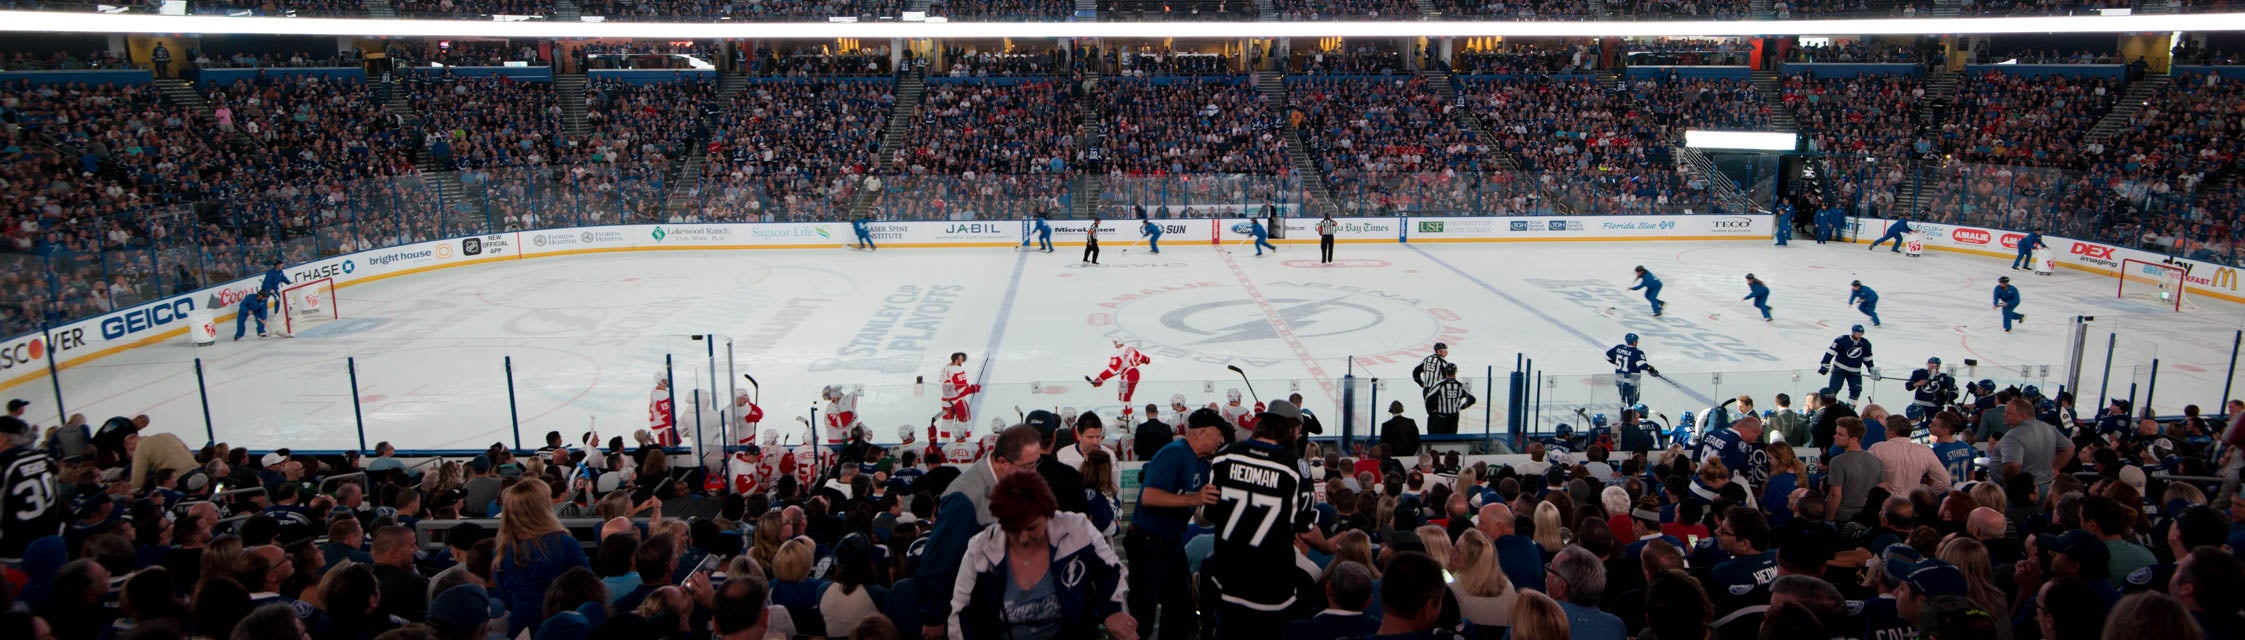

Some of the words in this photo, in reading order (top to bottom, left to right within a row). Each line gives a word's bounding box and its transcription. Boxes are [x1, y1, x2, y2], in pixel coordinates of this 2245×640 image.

[946, 223, 1001, 233] JABIL
[1166, 225, 1187, 234] SUN
[1345, 222, 1362, 233] Bay
[1363, 222, 1389, 232] Times
[1420, 222, 1444, 232] USF
[1602, 221, 1635, 230] Florida
[1638, 221, 1656, 230] Blue
[1711, 220, 1750, 228] TECO
[1923, 224, 1938, 232] CUP
[667, 227, 705, 235] Lakewood
[752, 226, 790, 239] Sagicor
[794, 226, 814, 236] Life
[482, 240, 509, 248] OFFICIAL
[2070, 242, 2117, 260] DEX
[369, 252, 399, 266] bright
[401, 248, 432, 260] house
[2080, 255, 2118, 268] imaging
[101, 297, 195, 340] GEICO
[886, 284, 964, 352] PLAYOFFS
[1426, 362, 1437, 372] 65
[1615, 354, 1629, 372] 51
[950, 447, 970, 458] GREEN
[742, 474, 752, 484] 3
[1229, 462, 1280, 489] HEDMAN
[1220, 485, 1284, 548] 77
